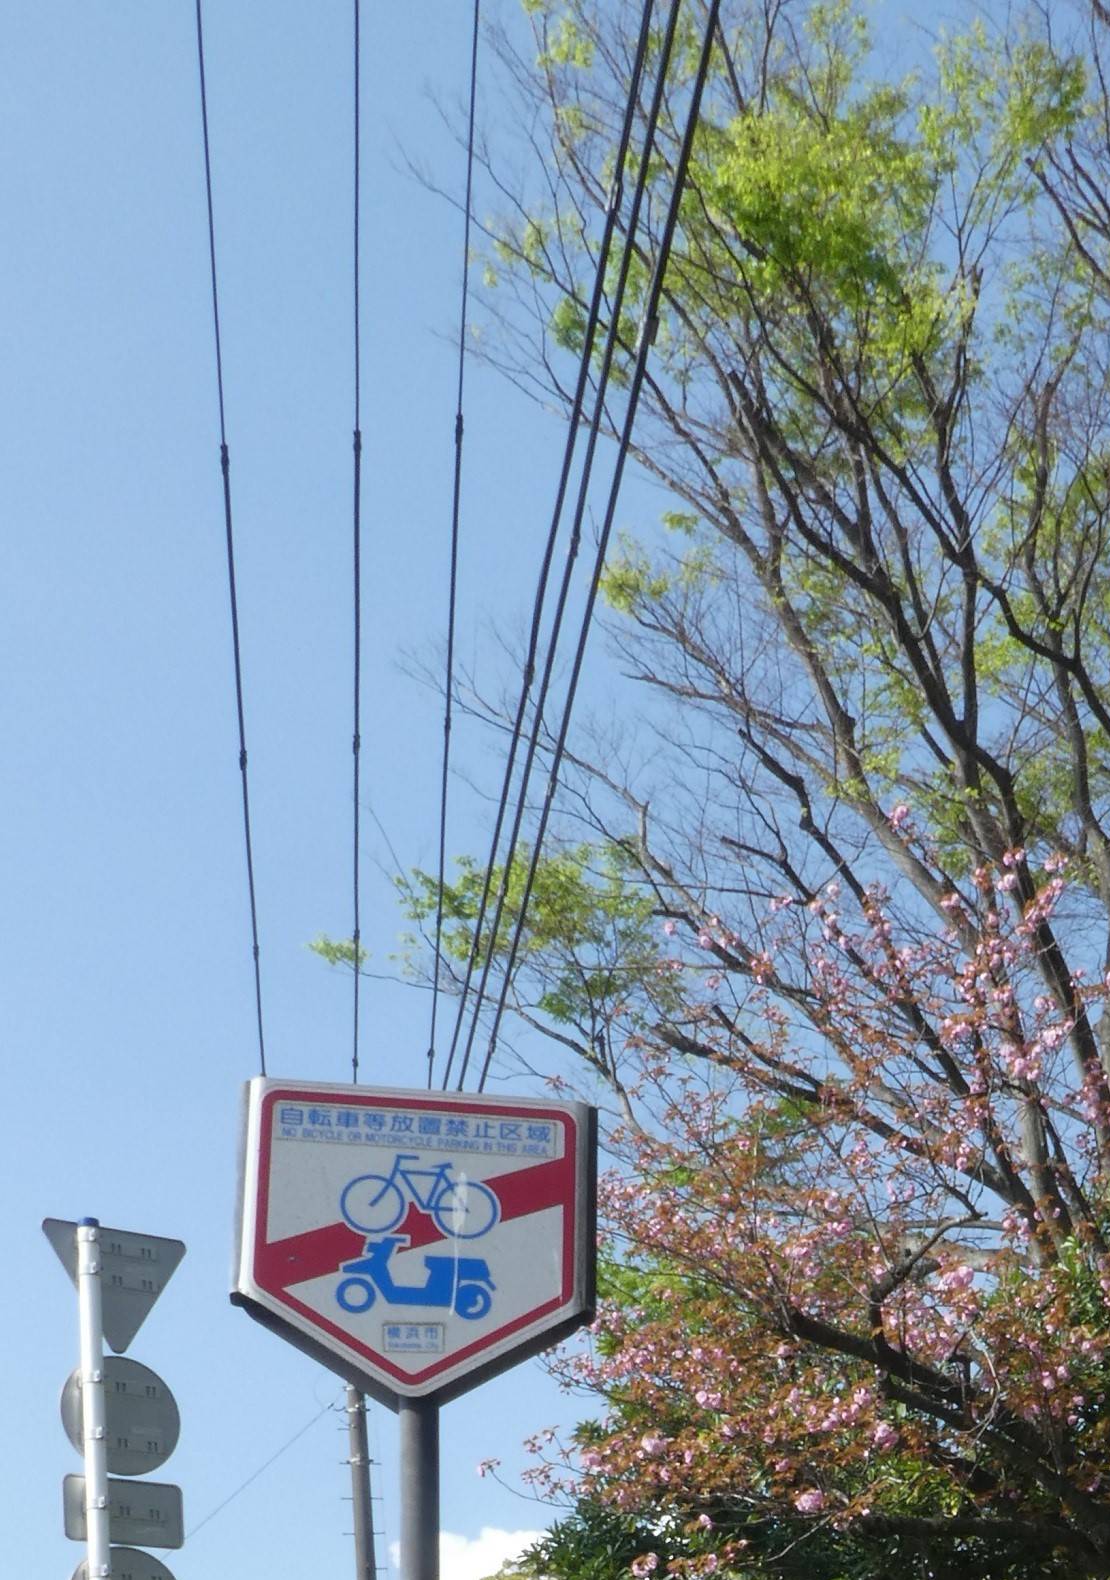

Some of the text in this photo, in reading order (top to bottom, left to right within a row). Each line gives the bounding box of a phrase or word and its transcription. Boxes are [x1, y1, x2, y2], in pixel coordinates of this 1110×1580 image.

[280, 1107, 551, 1144] 自転車等放置禁止区域
[282, 1127, 549, 1156] NO BICYCLE OR MOTORCYCLE PARKING IN THIS AREA
